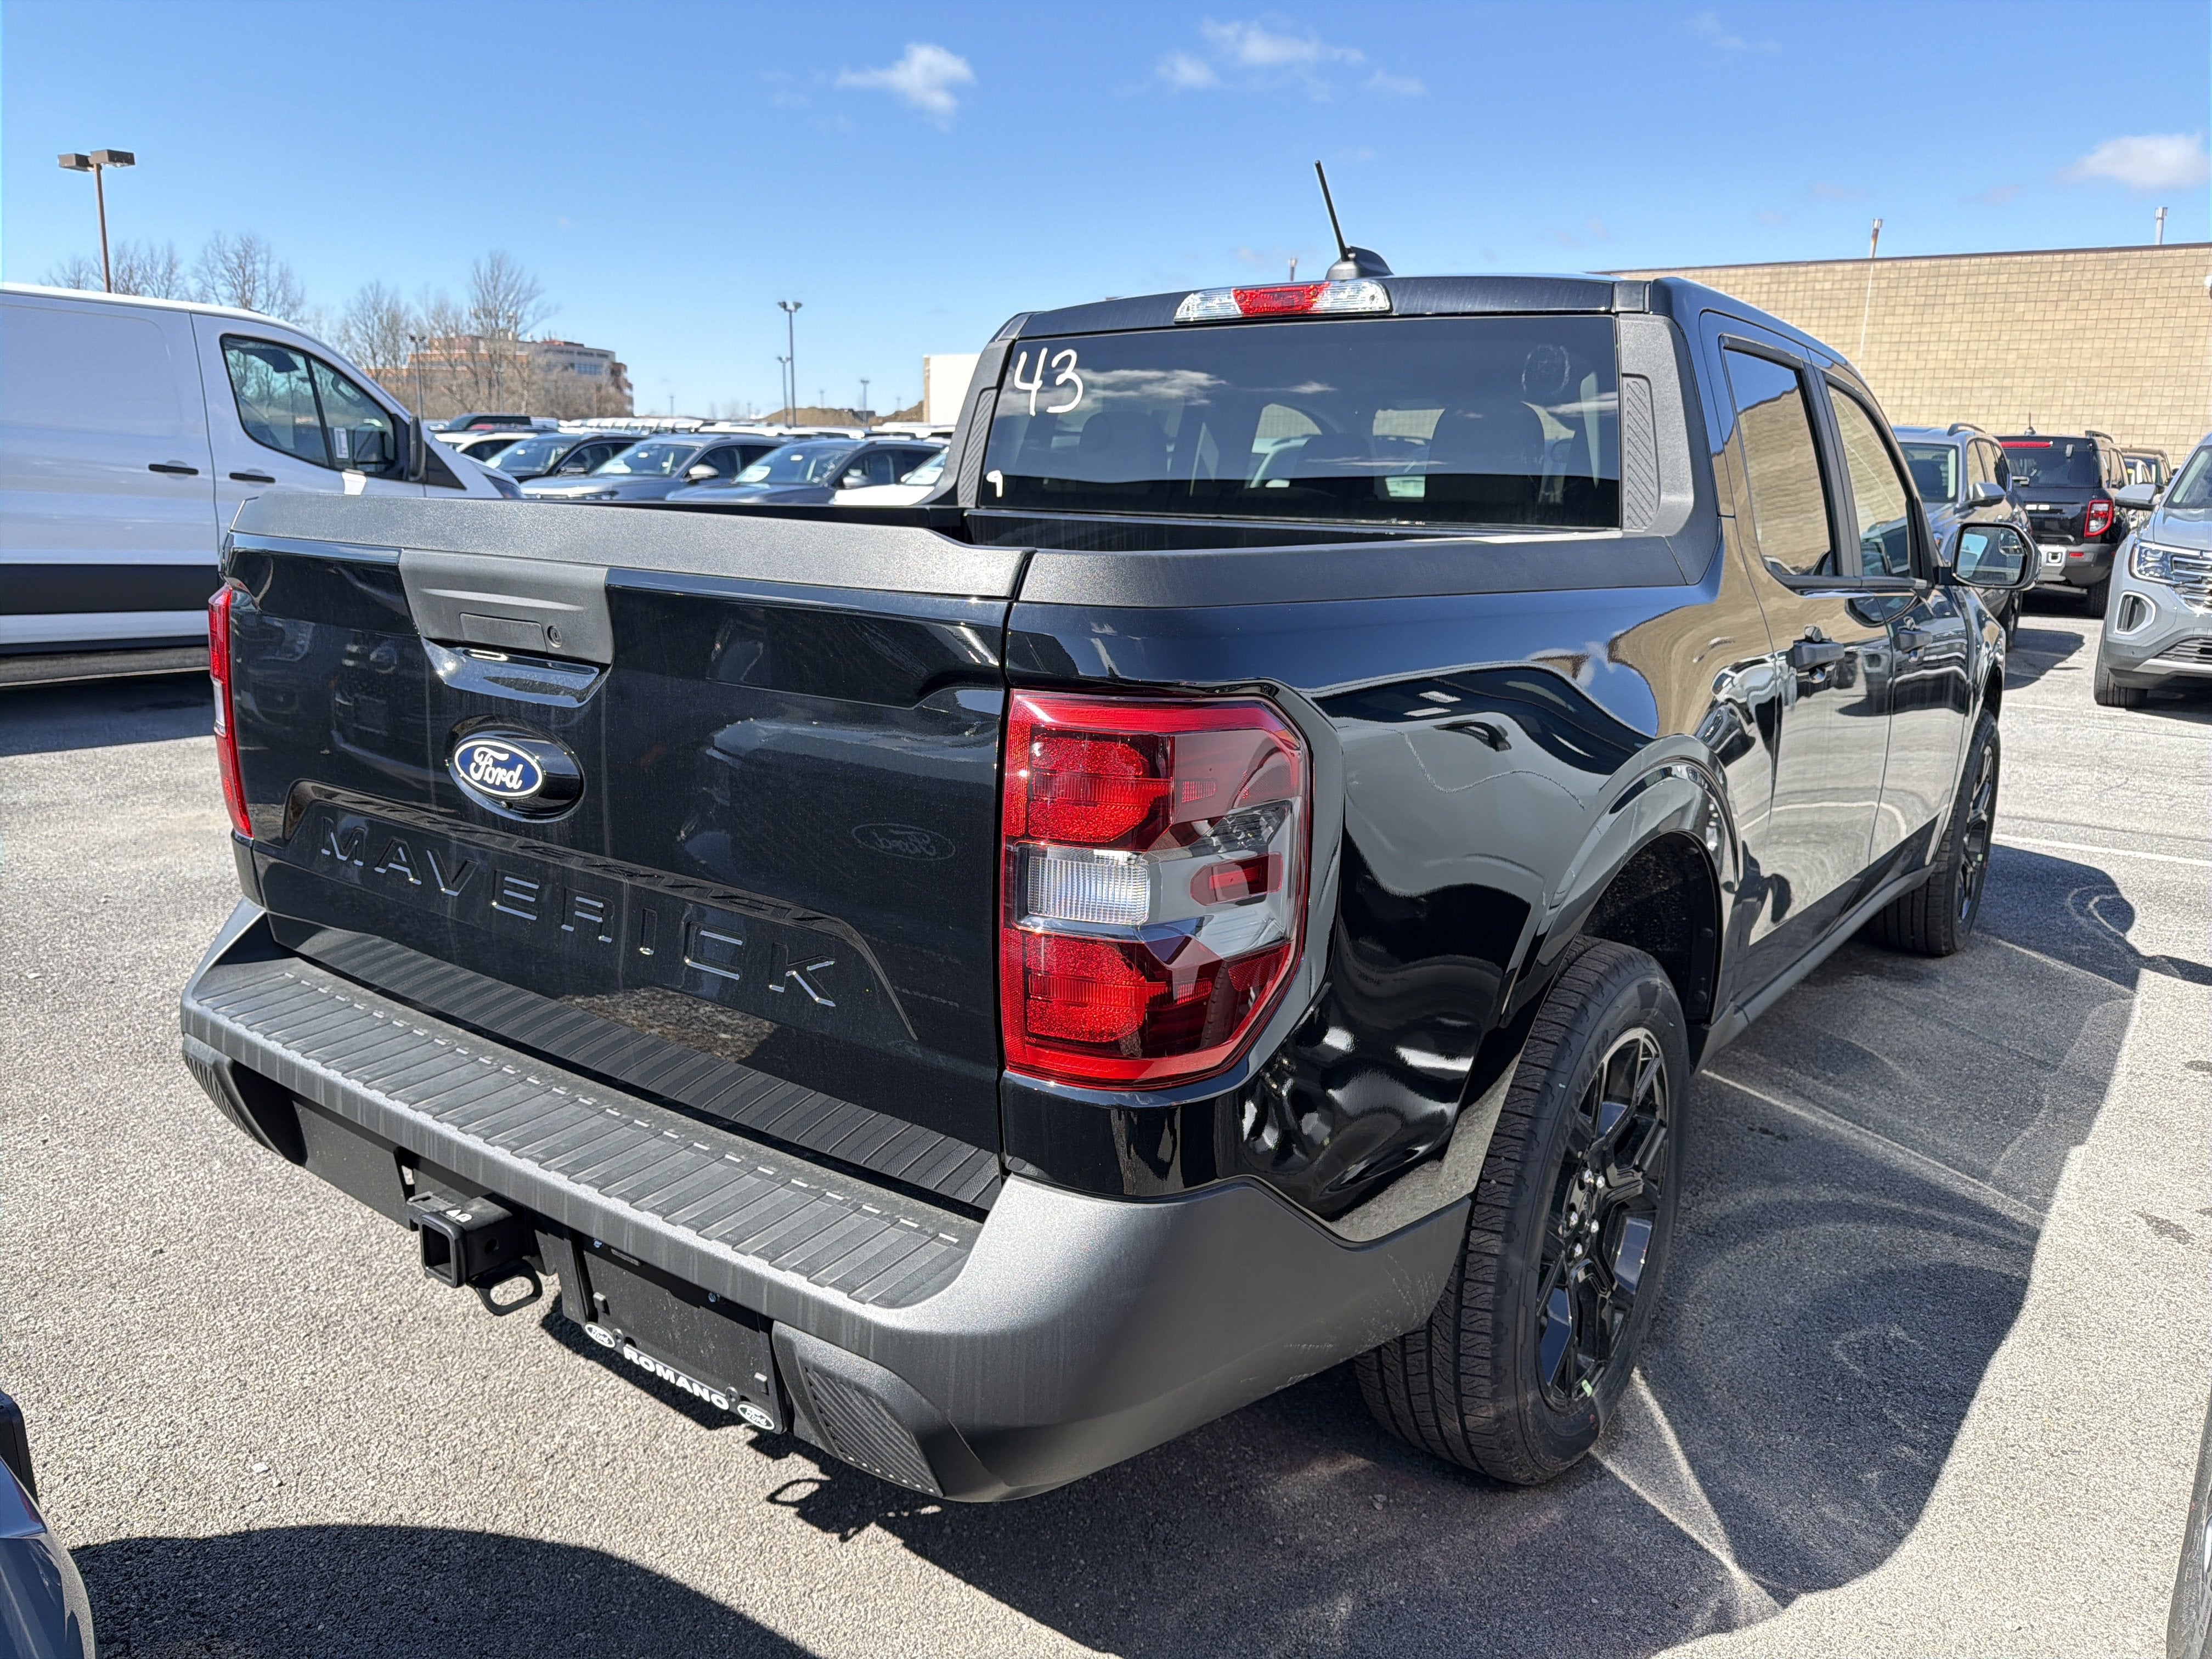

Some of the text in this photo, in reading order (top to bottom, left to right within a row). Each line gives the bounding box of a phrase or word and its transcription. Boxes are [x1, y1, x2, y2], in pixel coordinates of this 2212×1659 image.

[1014, 347, 1084, 416] 43
[470, 746, 523, 790] Ford
[321, 816, 836, 1007] MAVERICK
[623, 1346, 729, 1410] ROMANO
